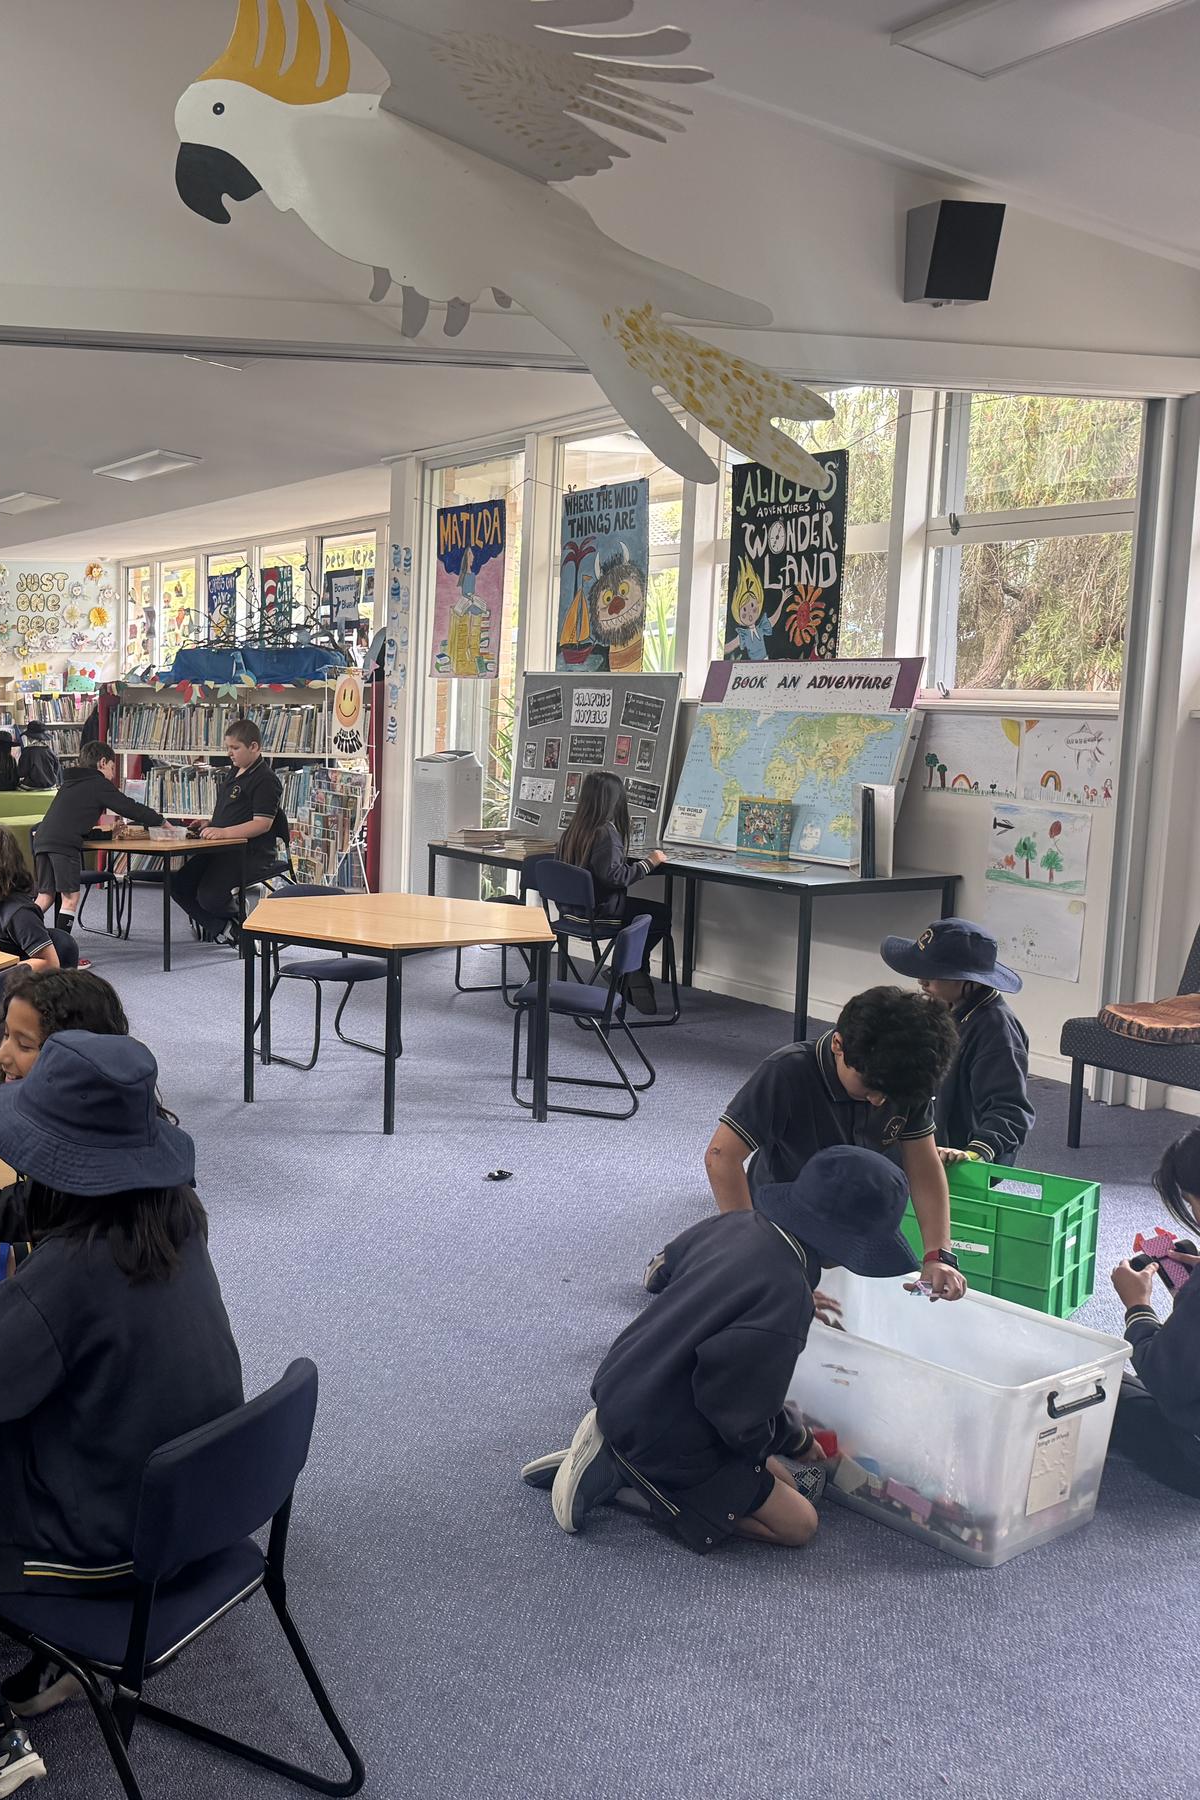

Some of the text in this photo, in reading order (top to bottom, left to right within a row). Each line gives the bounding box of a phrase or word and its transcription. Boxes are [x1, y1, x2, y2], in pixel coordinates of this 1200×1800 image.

[565, 485, 638, 516] WHERE THE WILD
[736, 460, 838, 517] ALICS
[757, 501, 826, 517] ADVENTURES IN
[439, 506, 502, 555] MATILDA
[568, 510, 636, 538] THINGS ARE
[16, 572, 69, 592] JUST
[764, 552, 838, 590] LAND
[277, 580, 291, 603] CAT
[731, 675, 893, 690] BOOK AN ADVENTURE
[574, 710, 608, 724] NOVELS
